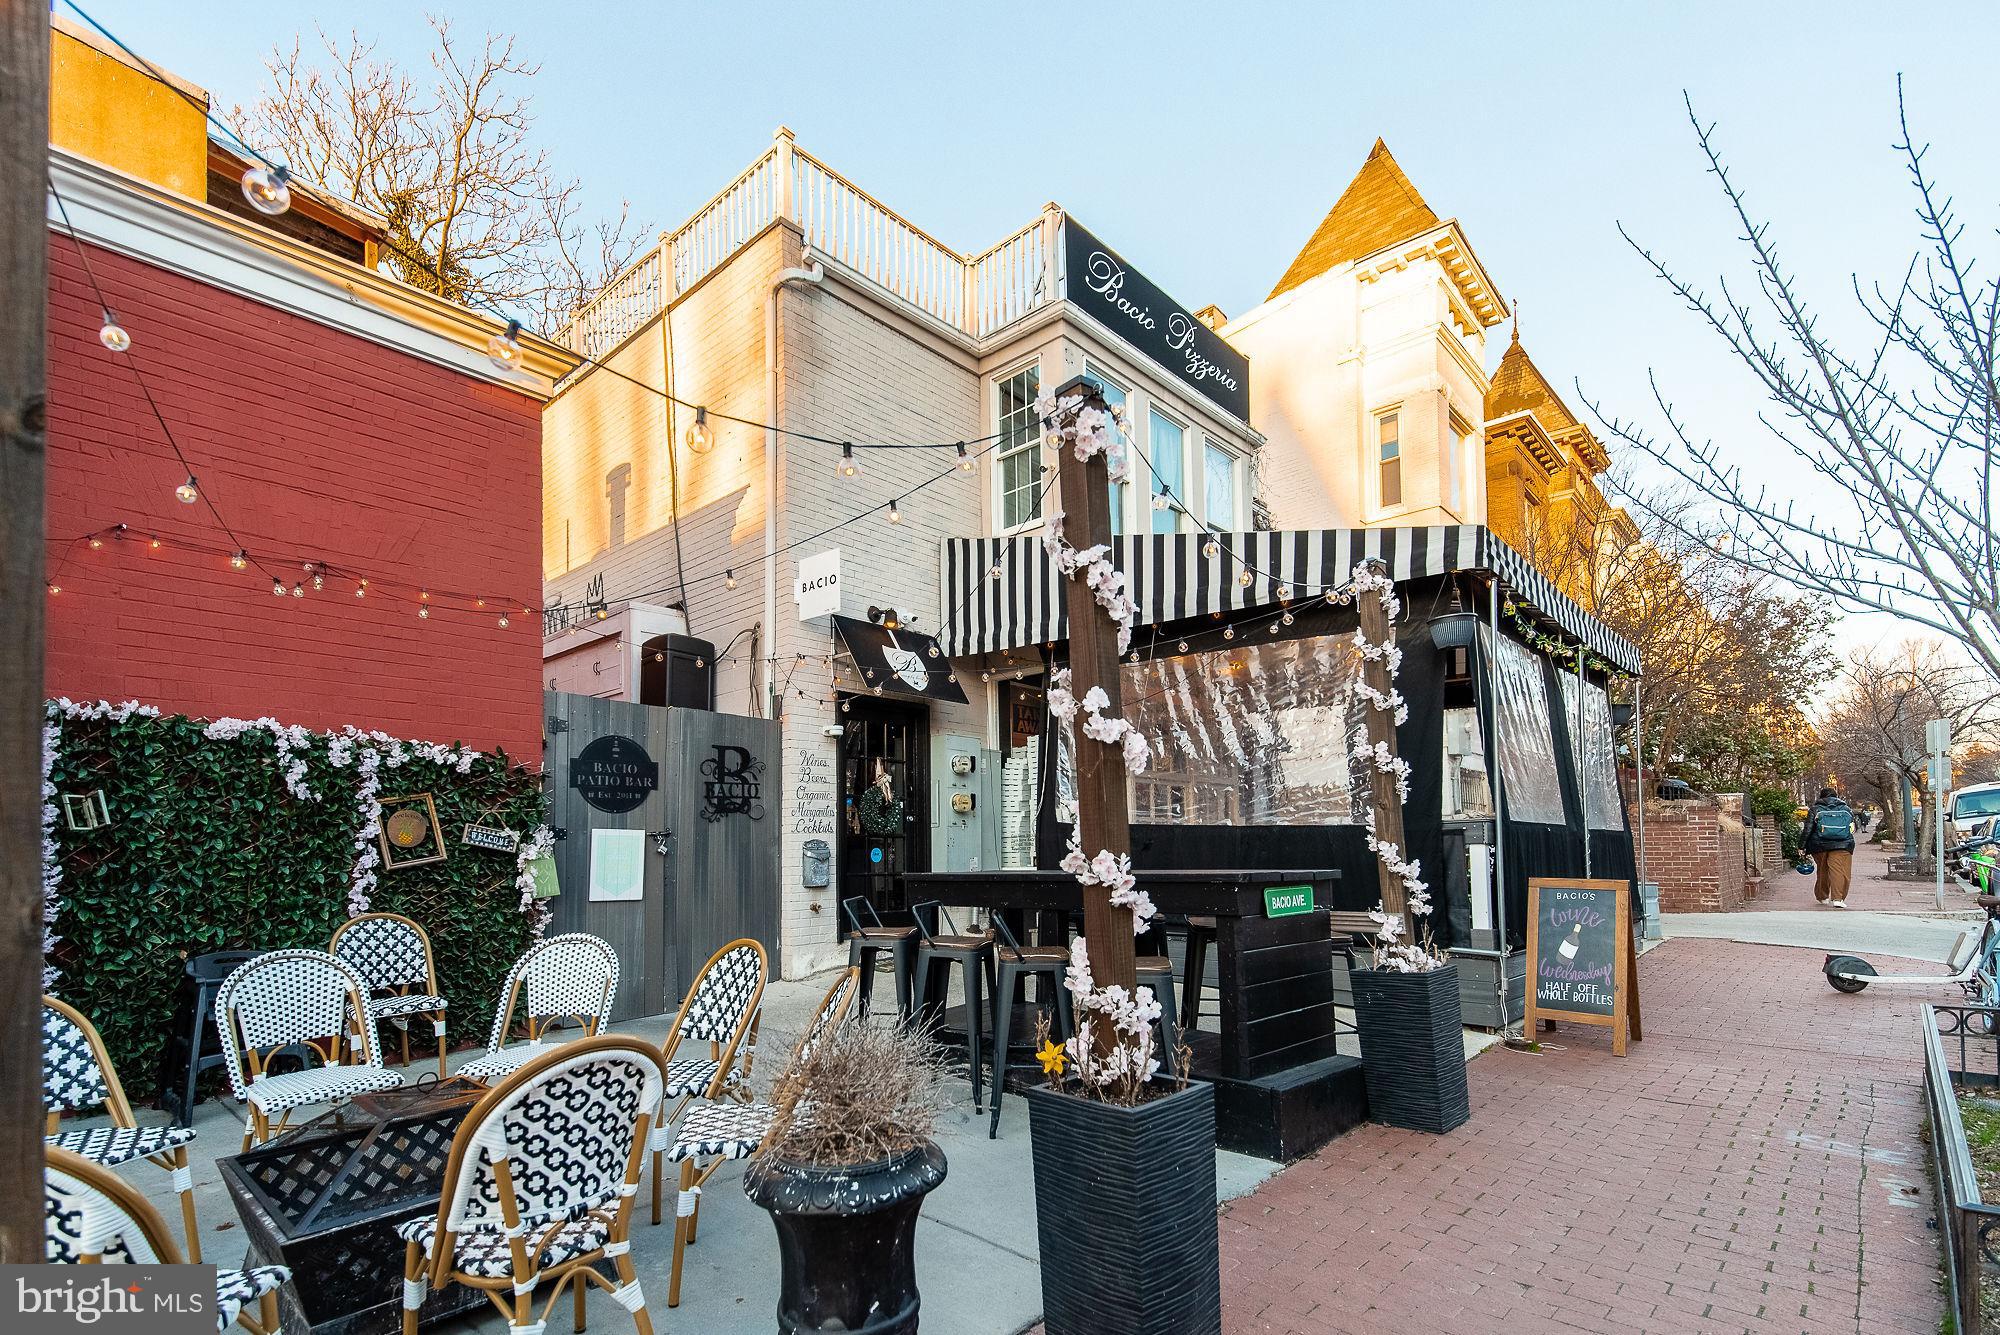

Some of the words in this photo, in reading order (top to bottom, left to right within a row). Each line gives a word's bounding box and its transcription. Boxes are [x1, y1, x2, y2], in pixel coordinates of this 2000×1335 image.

[1085, 251, 1156, 330] Bacio
[1166, 312, 1238, 392] Pizzeria
[802, 574, 837, 593] BACIO
[593, 762, 638, 774] BACIO
[577, 774, 620, 786] PATIO
[625, 776, 653, 787] BAR
[705, 784, 759, 798] BACIO
[471, 831, 510, 846] WELCOME
[1272, 895, 1292, 909] BACIO
[1292, 894, 1307, 907] AVE.
[1556, 892, 1596, 901] BACIO'S
[1545, 981, 1572, 992] HALF
[1578, 983, 1599, 994] OFF
[1537, 988, 1569, 1001] WHOLE
[1573, 992, 1613, 1006] BOTTLES
